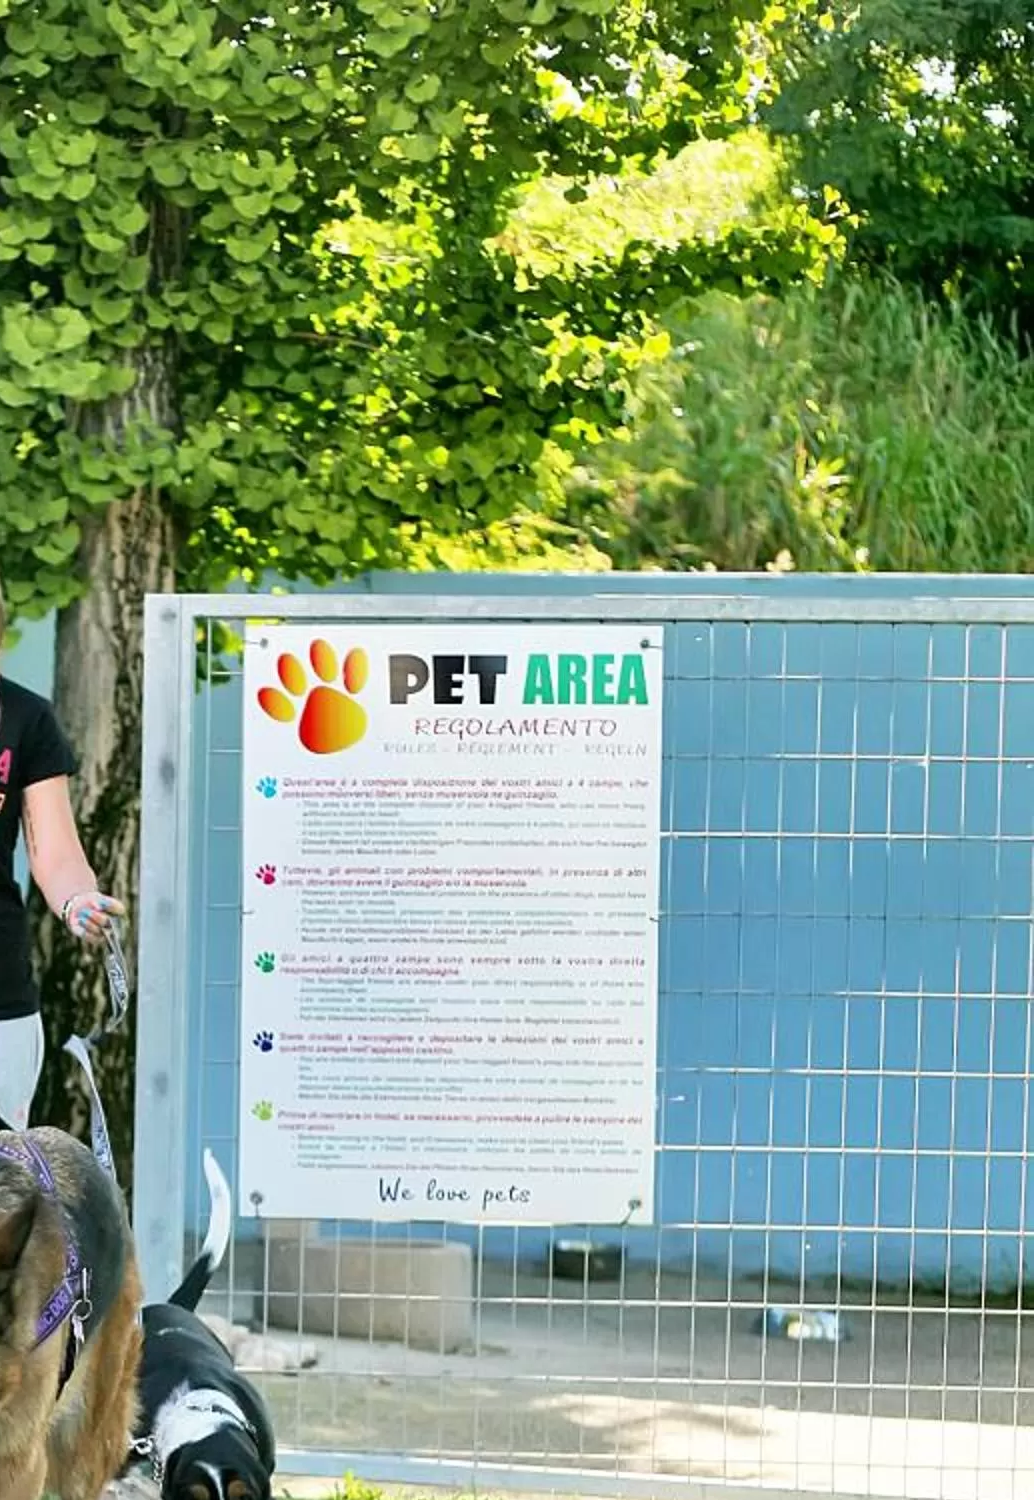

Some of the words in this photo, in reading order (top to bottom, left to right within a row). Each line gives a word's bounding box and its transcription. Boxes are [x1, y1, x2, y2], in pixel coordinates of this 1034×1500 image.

[388, 653, 508, 706] PET
[522, 653, 649, 706] AREA
[415, 717, 618, 741] REGOLAMENTO
[378, 1176, 414, 1203] We
[426, 1177, 470, 1201] love
[481, 1184, 532, 1211] pets
